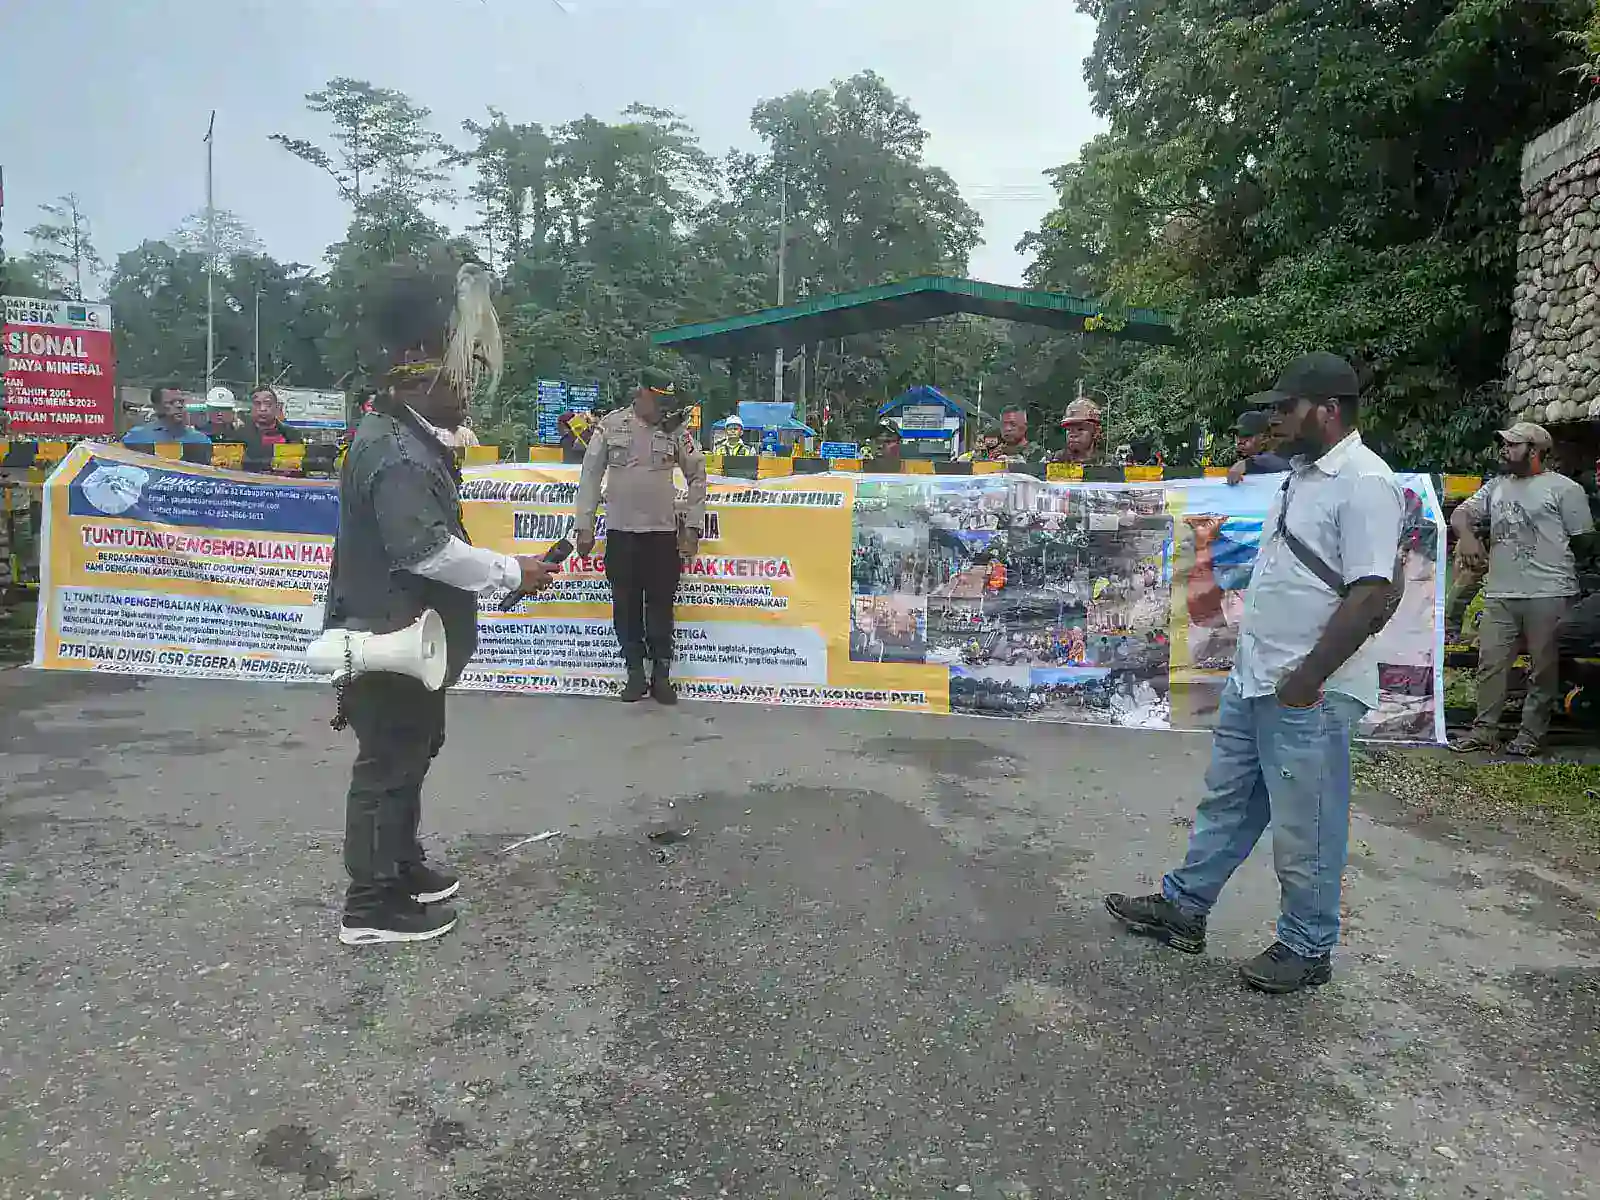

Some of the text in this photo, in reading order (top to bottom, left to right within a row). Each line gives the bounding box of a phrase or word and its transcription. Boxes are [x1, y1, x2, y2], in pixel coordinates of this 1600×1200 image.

[4, 332, 88, 358] SIONAL
[9, 359, 103, 376] DAYA MINERAL
[16, 388, 47, 397] TAHUN
[50, 413, 81, 424] TANPA
[85, 414, 104, 424] IZIN
[514, 513, 564, 539] KEPADA
[82, 526, 164, 549] TUNTUTAN
[166, 534, 297, 560] PENGEMBALIAN
[98, 552, 156, 564] BERDASARKAN
[259, 567, 283, 577] SURAT
[723, 560, 792, 577] KETIGA
[86, 562, 103, 572] KAMI
[105, 564, 138, 574] DENGAN
[211, 574, 236, 584] BESAR
[276, 580, 311, 591] MELALUI
[560, 592, 582, 601] ADAT
[684, 584, 702, 593] SAH
[704, 585, 723, 594] DAN
[73, 593, 121, 604] TUNTUTAN
[124, 596, 200, 610] PENGEMBALIAN
[203, 602, 223, 613] HAK
[225, 604, 249, 615] YANG
[250, 607, 304, 623] DIABAIKAN
[686, 596, 714, 605] TEGAS
[717, 597, 788, 609] MENYAMPAIKAN
[476, 624, 547, 635] PENGHENTIAN
[550, 625, 583, 635] TOTAL
[59, 643, 86, 656] PTFI
[88, 646, 114, 660] DAN
[116, 649, 156, 664] DIVISI
[158, 652, 184, 666] CSR
[186, 654, 237, 670] SEGERA
[719, 685, 776, 698] ULAYAT
